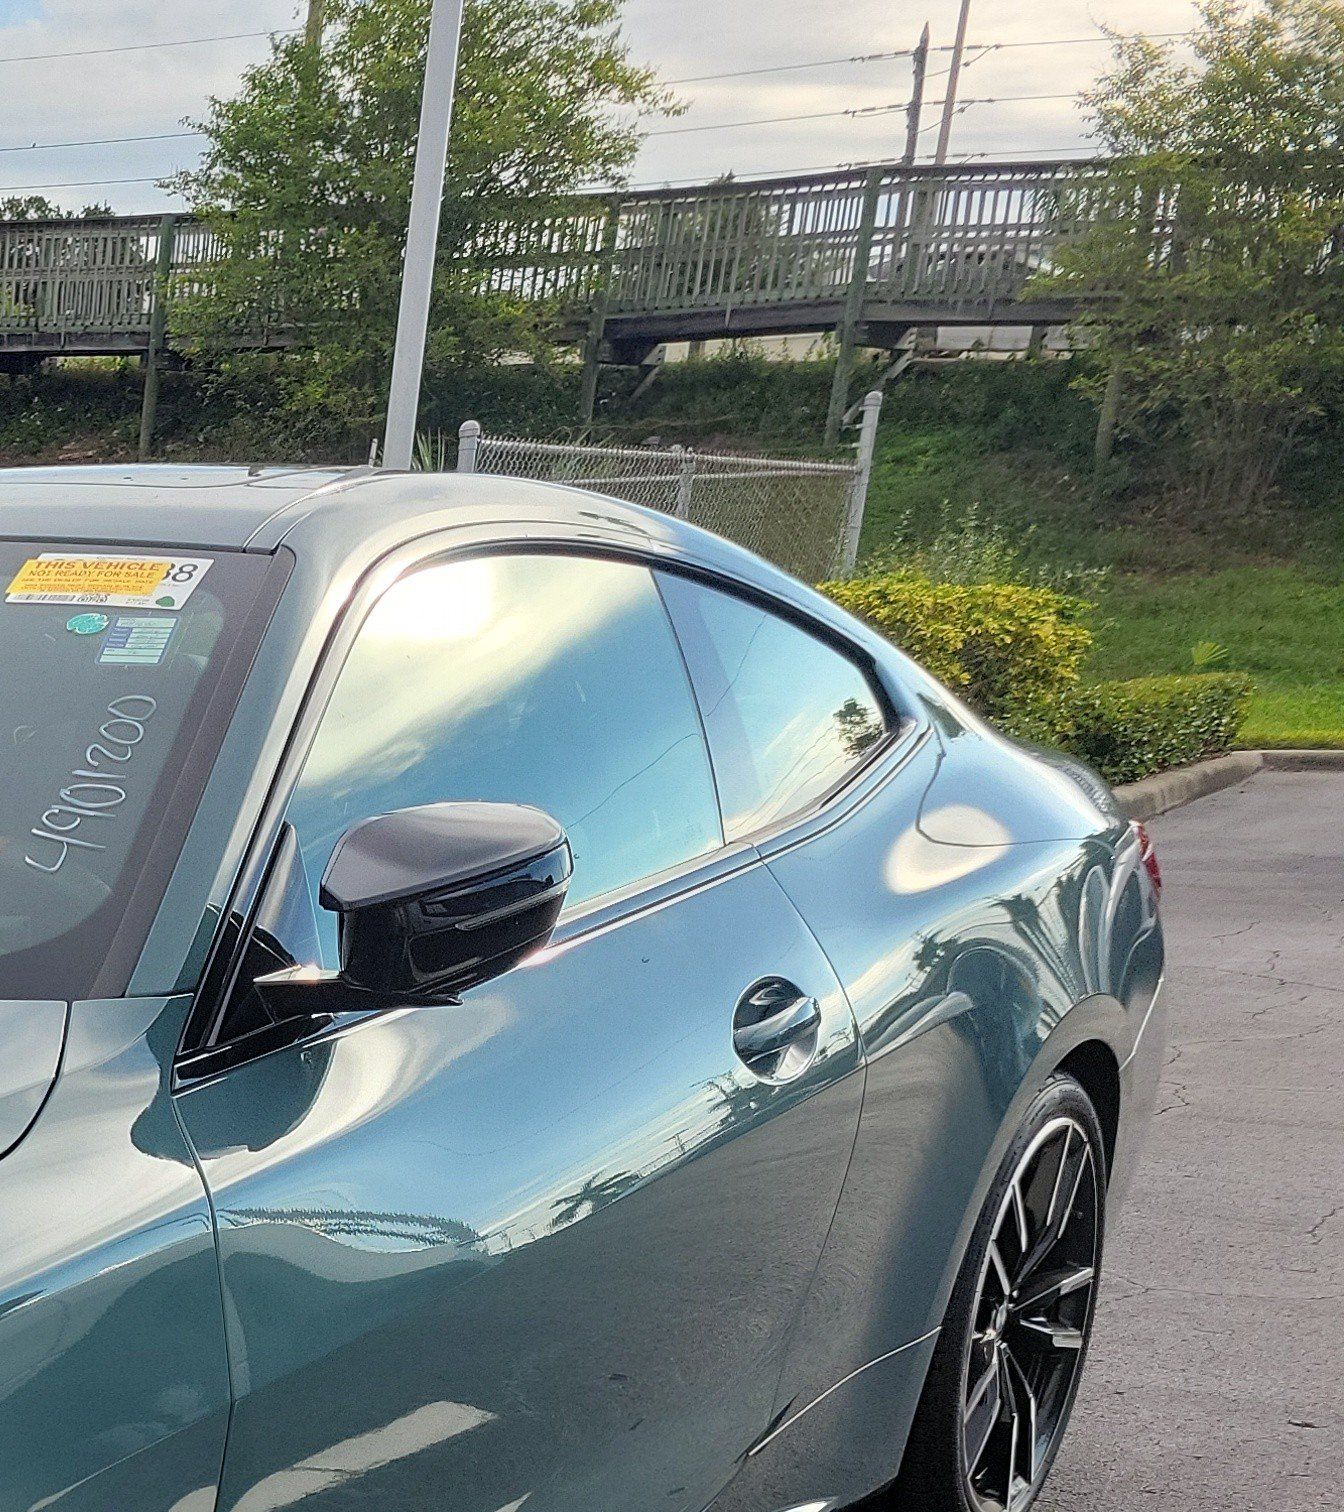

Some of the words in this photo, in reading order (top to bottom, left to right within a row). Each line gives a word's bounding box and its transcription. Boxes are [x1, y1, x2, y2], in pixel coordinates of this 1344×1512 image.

[35, 561, 76, 570] THIS
[82, 561, 163, 571] VEHICLE
[96, 570, 122, 578] FOR
[124, 571, 155, 579] SALE
[25, 695, 157, 872] 4901200
